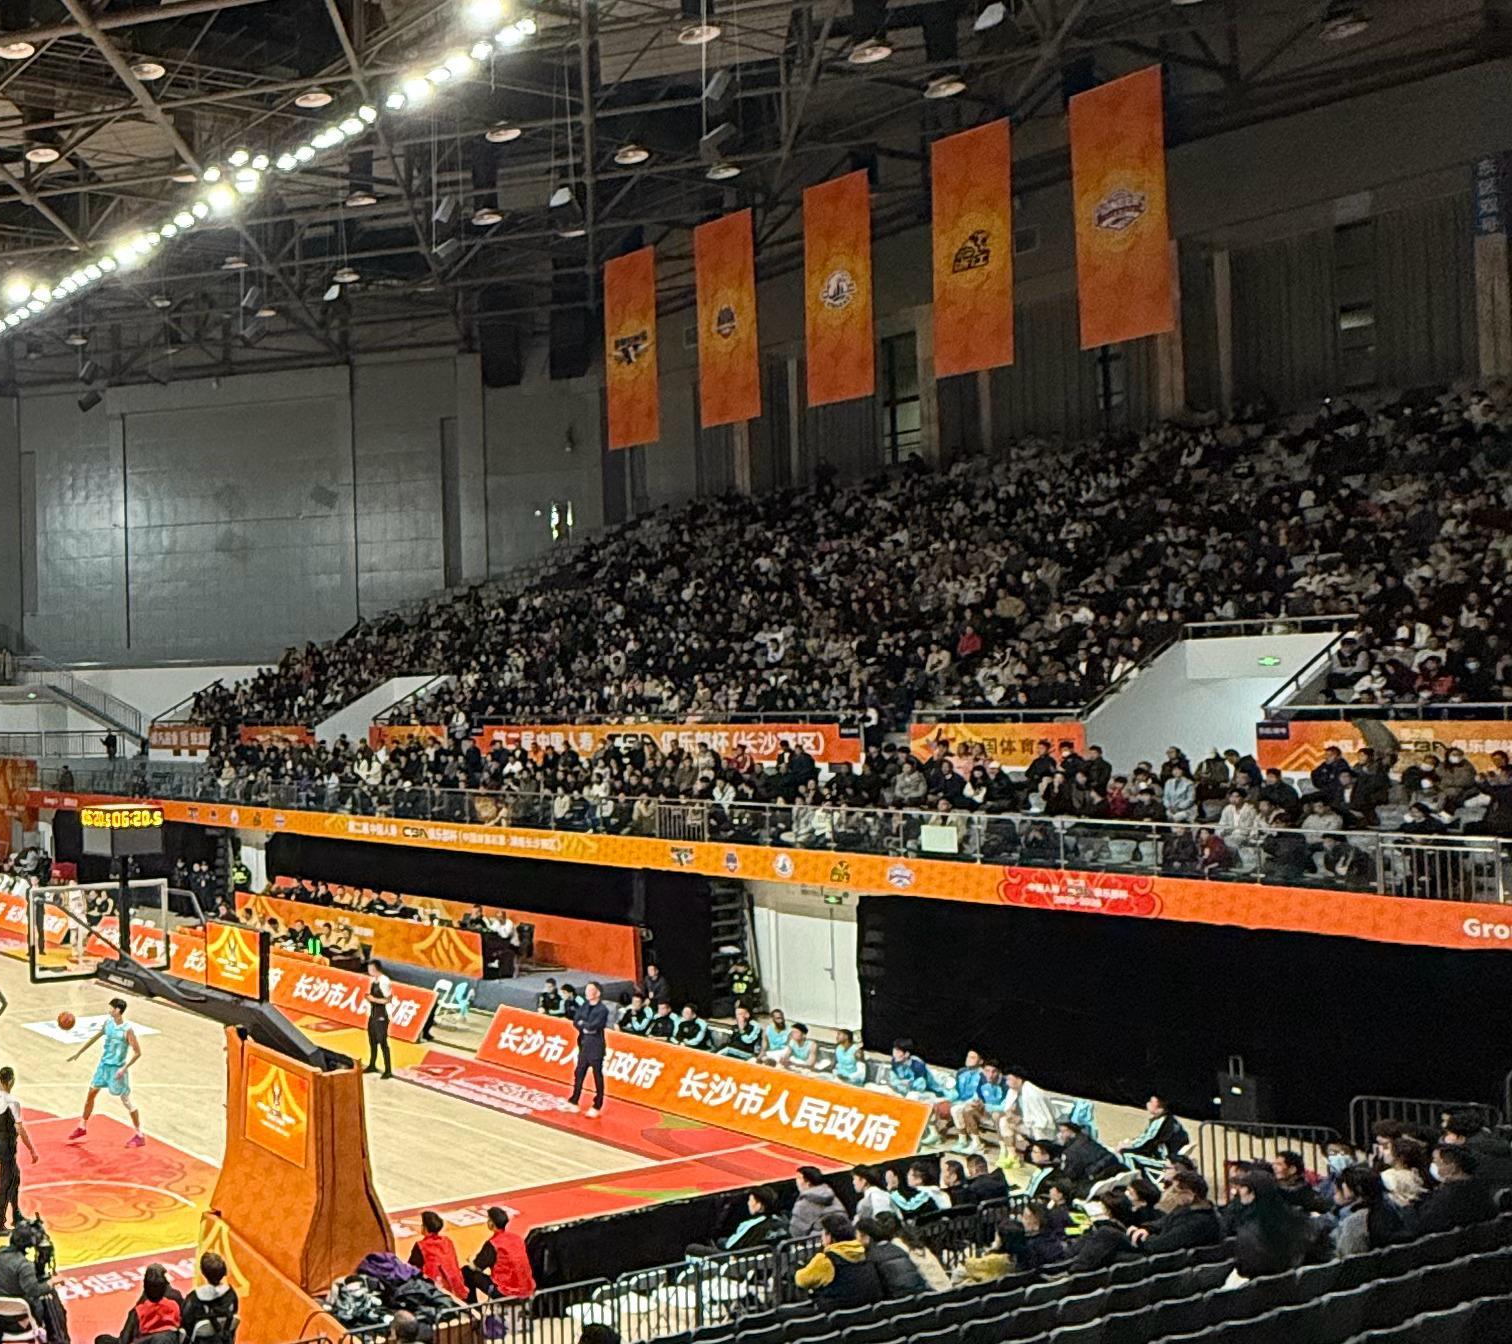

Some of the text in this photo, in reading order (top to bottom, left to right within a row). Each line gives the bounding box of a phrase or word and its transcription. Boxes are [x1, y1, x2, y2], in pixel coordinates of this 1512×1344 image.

[1463, 918, 1512, 940] Gro
[677, 1067, 901, 1152] 长沙市人民政府
